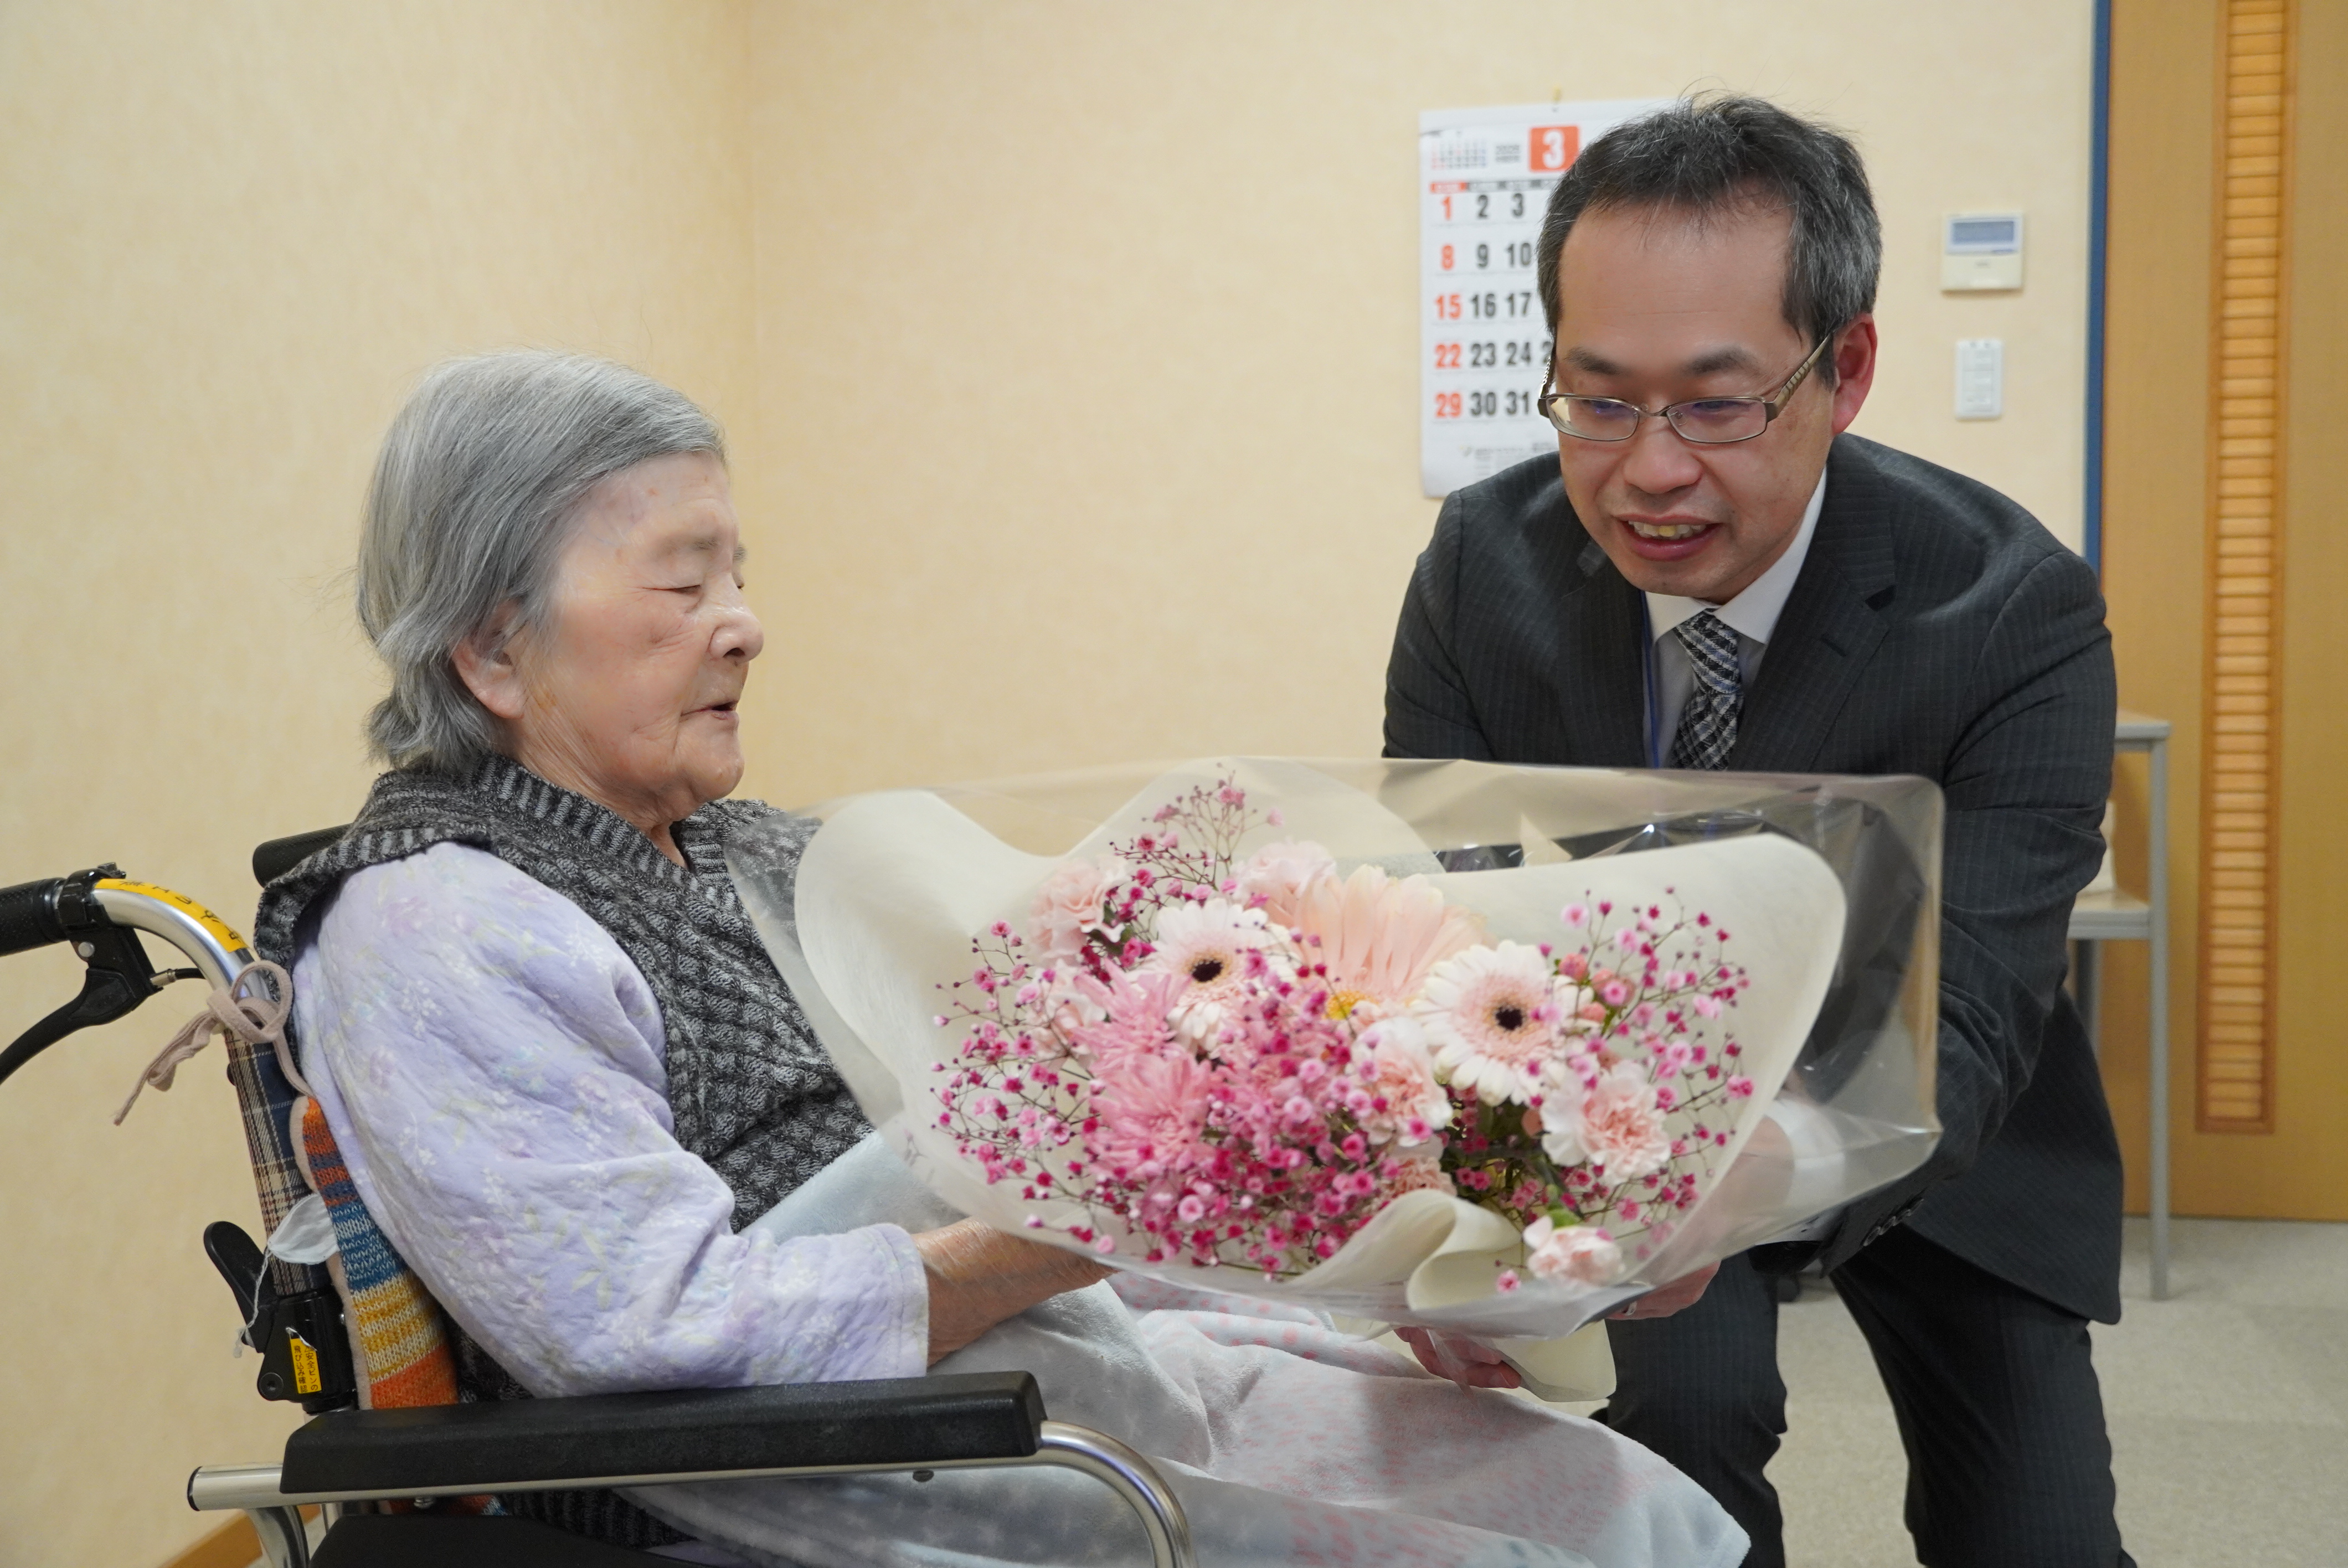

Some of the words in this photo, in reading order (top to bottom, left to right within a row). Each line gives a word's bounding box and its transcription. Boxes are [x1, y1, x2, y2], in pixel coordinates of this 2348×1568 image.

[1543, 130, 1564, 168] 3
[1441, 196, 1451, 220] 1
[1477, 193, 1489, 219] 2
[1512, 192, 1525, 218] 3
[1441, 244, 1455, 270] 8
[1477, 243, 1489, 269] 9
[1506, 242, 1531, 267] 10
[1435, 294, 1461, 319] 15
[1470, 292, 1496, 318] 16
[1506, 291, 1532, 317] 17
[1435, 343, 1461, 368] 22
[1471, 342, 1496, 367] 23
[1506, 341, 1532, 367] 24
[1435, 393, 1461, 418] 29
[1471, 391, 1496, 416] 30
[1506, 391, 1530, 416] 31
